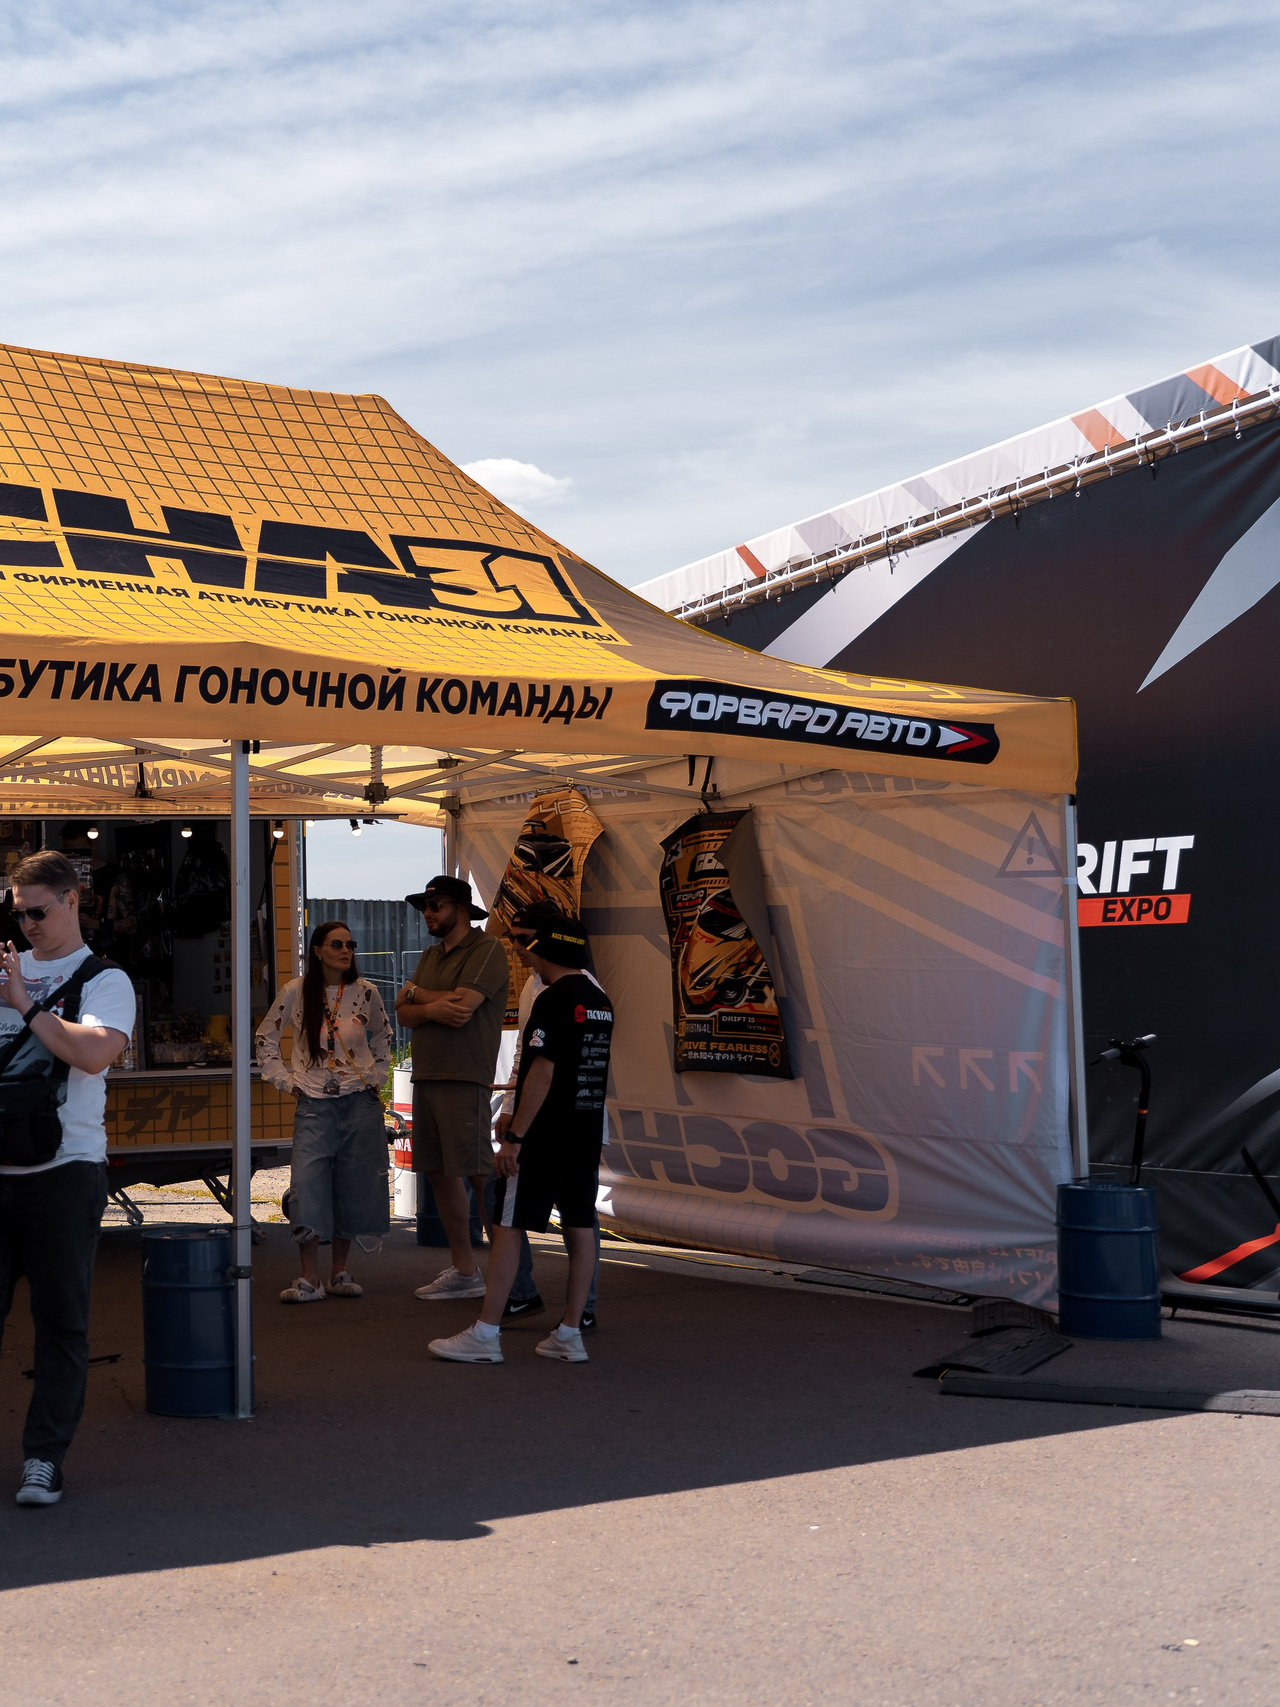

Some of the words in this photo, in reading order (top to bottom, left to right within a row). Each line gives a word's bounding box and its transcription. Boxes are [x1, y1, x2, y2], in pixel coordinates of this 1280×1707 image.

[13, 571, 190, 600] ФИРМЕННАЯ
[198, 590, 358, 619] АТРИБУТИКА
[362, 610, 494, 633] ГОНОЧНОЙ
[498, 623, 618, 643] КОМАНДЫ
[174, 664, 406, 712] ГОНОЧНОЙ
[415, 676, 613, 724] КОМАНДЫ
[659, 690, 838, 735] ФОРВАРД
[836, 711, 932, 747] АВТО
[1077, 835, 1195, 894] RIFT
[1101, 896, 1172, 923] EXPO
[682, 1041, 707, 1050] RIVE
[710, 1042, 768, 1054] FEARLESS
